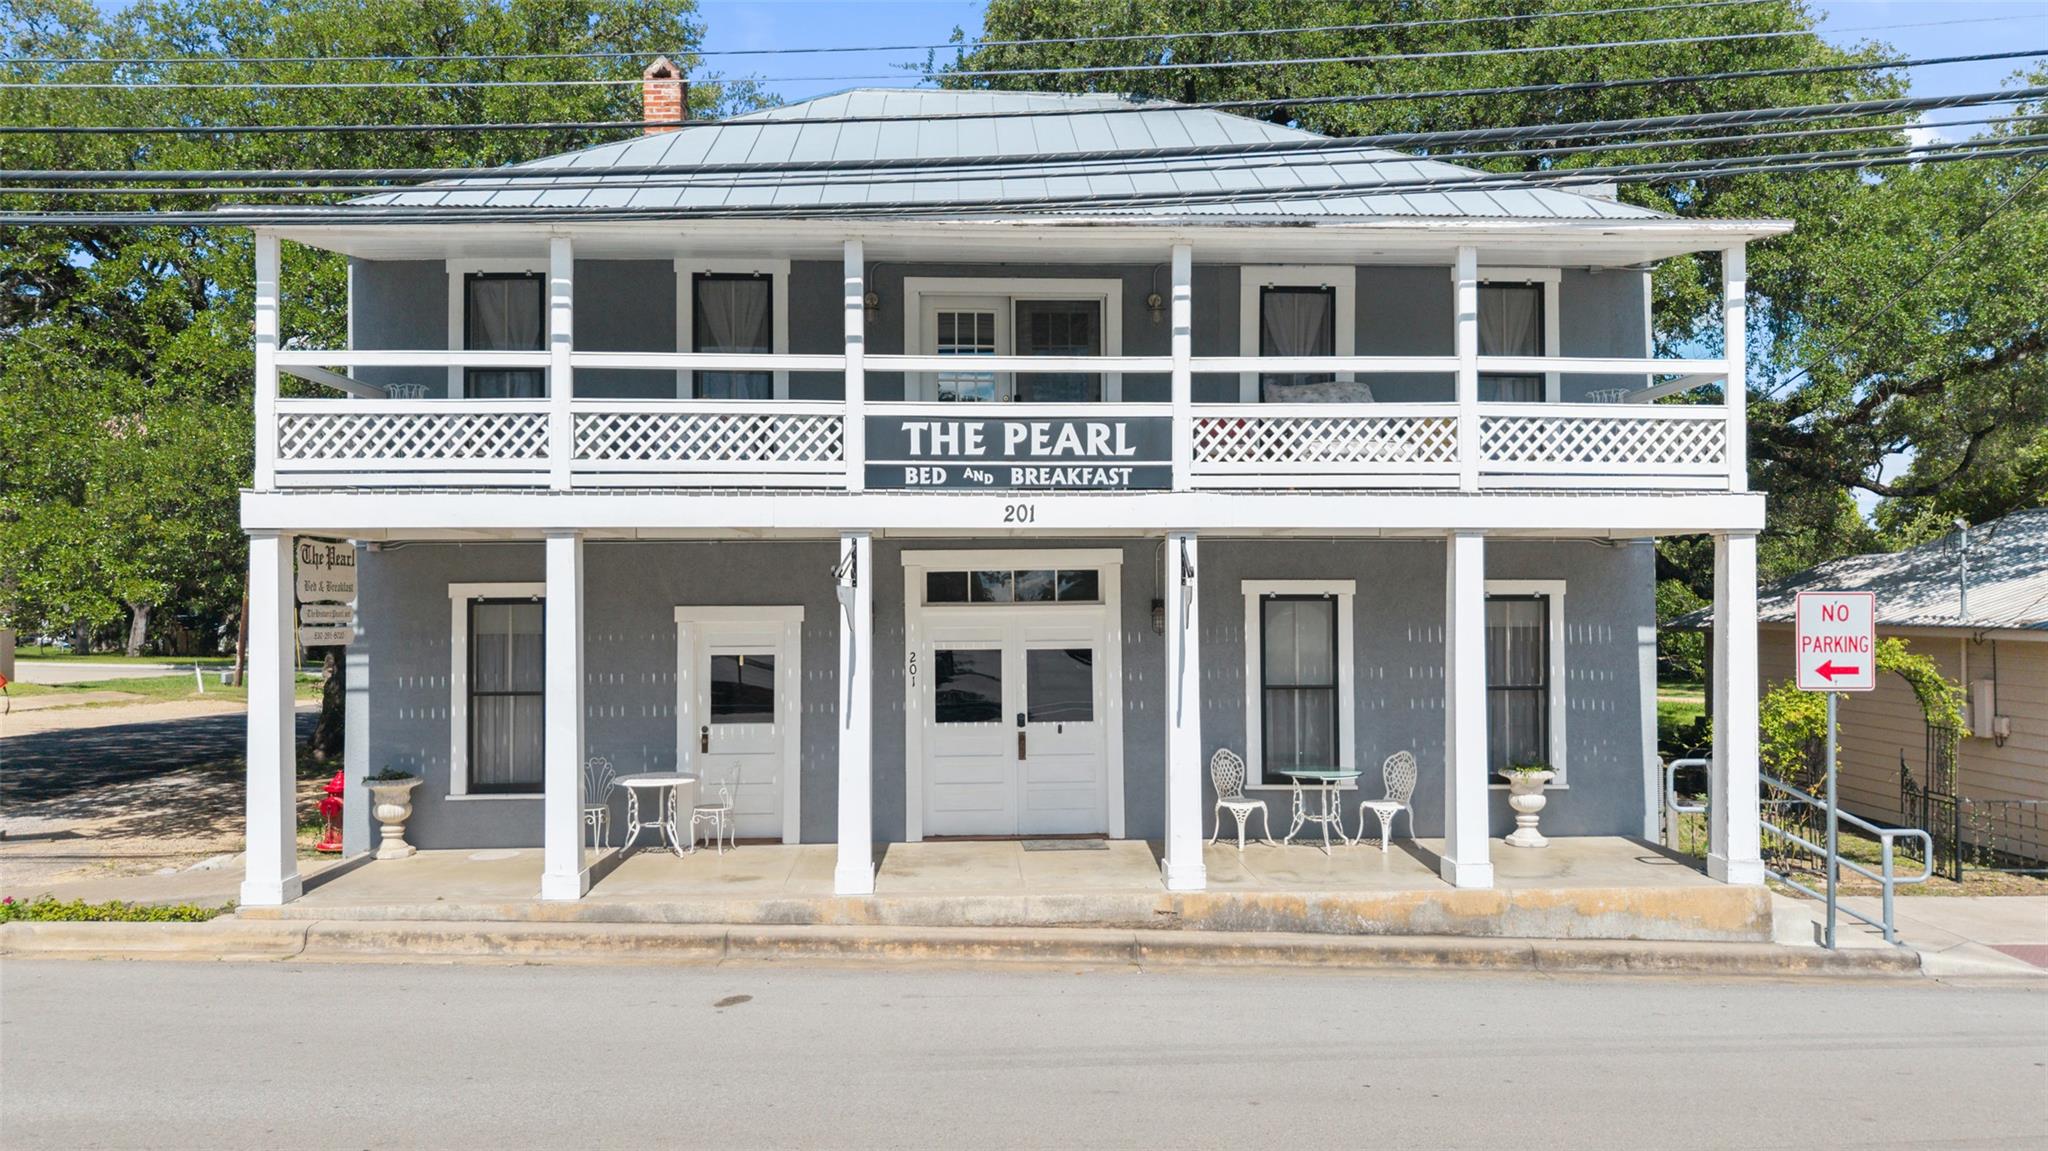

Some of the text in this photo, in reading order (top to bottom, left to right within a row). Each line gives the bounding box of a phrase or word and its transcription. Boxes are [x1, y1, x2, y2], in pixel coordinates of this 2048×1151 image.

[901, 422, 1137, 456] THE PEARL
[904, 467, 1133, 485] BED AND BREAKFAST
[1003, 504, 1036, 523] 201
[301, 544, 356, 570] The Pearl
[304, 580, 317, 593] Bed
[318, 581, 325, 593] &
[1822, 604, 1849, 622] NO
[1802, 635, 1869, 653] PARKING
[909, 651, 917, 688] 201
